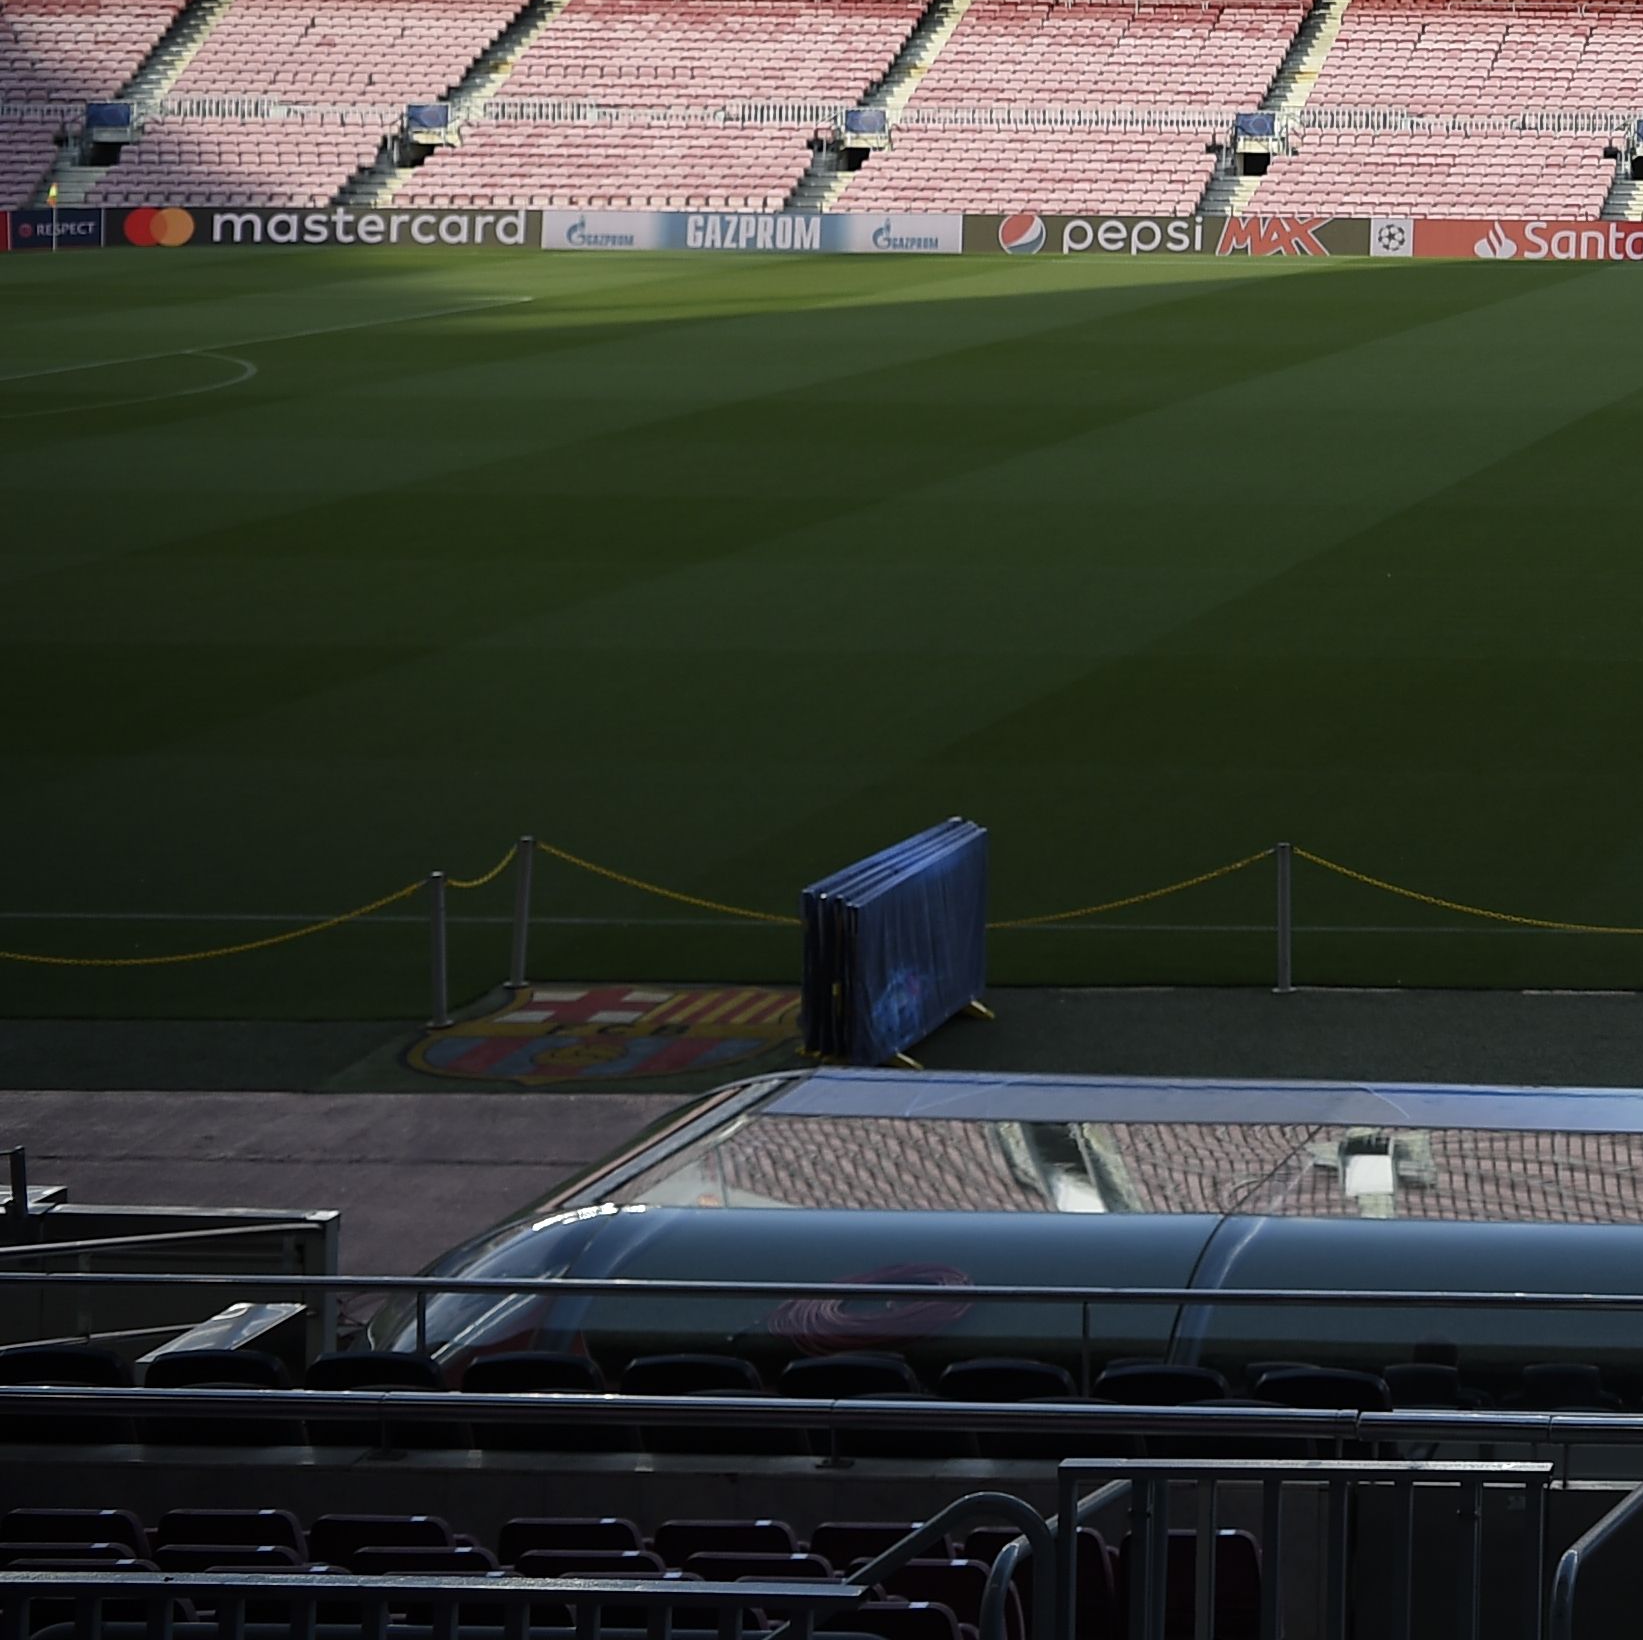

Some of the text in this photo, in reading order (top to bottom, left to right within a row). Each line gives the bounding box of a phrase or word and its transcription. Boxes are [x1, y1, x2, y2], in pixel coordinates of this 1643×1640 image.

[36, 221, 94, 237] RESPECT
[212, 208, 526, 246] mastercard
[686, 215, 821, 249] GAZPROM
[1062, 216, 1330, 256] pepsi MAX
